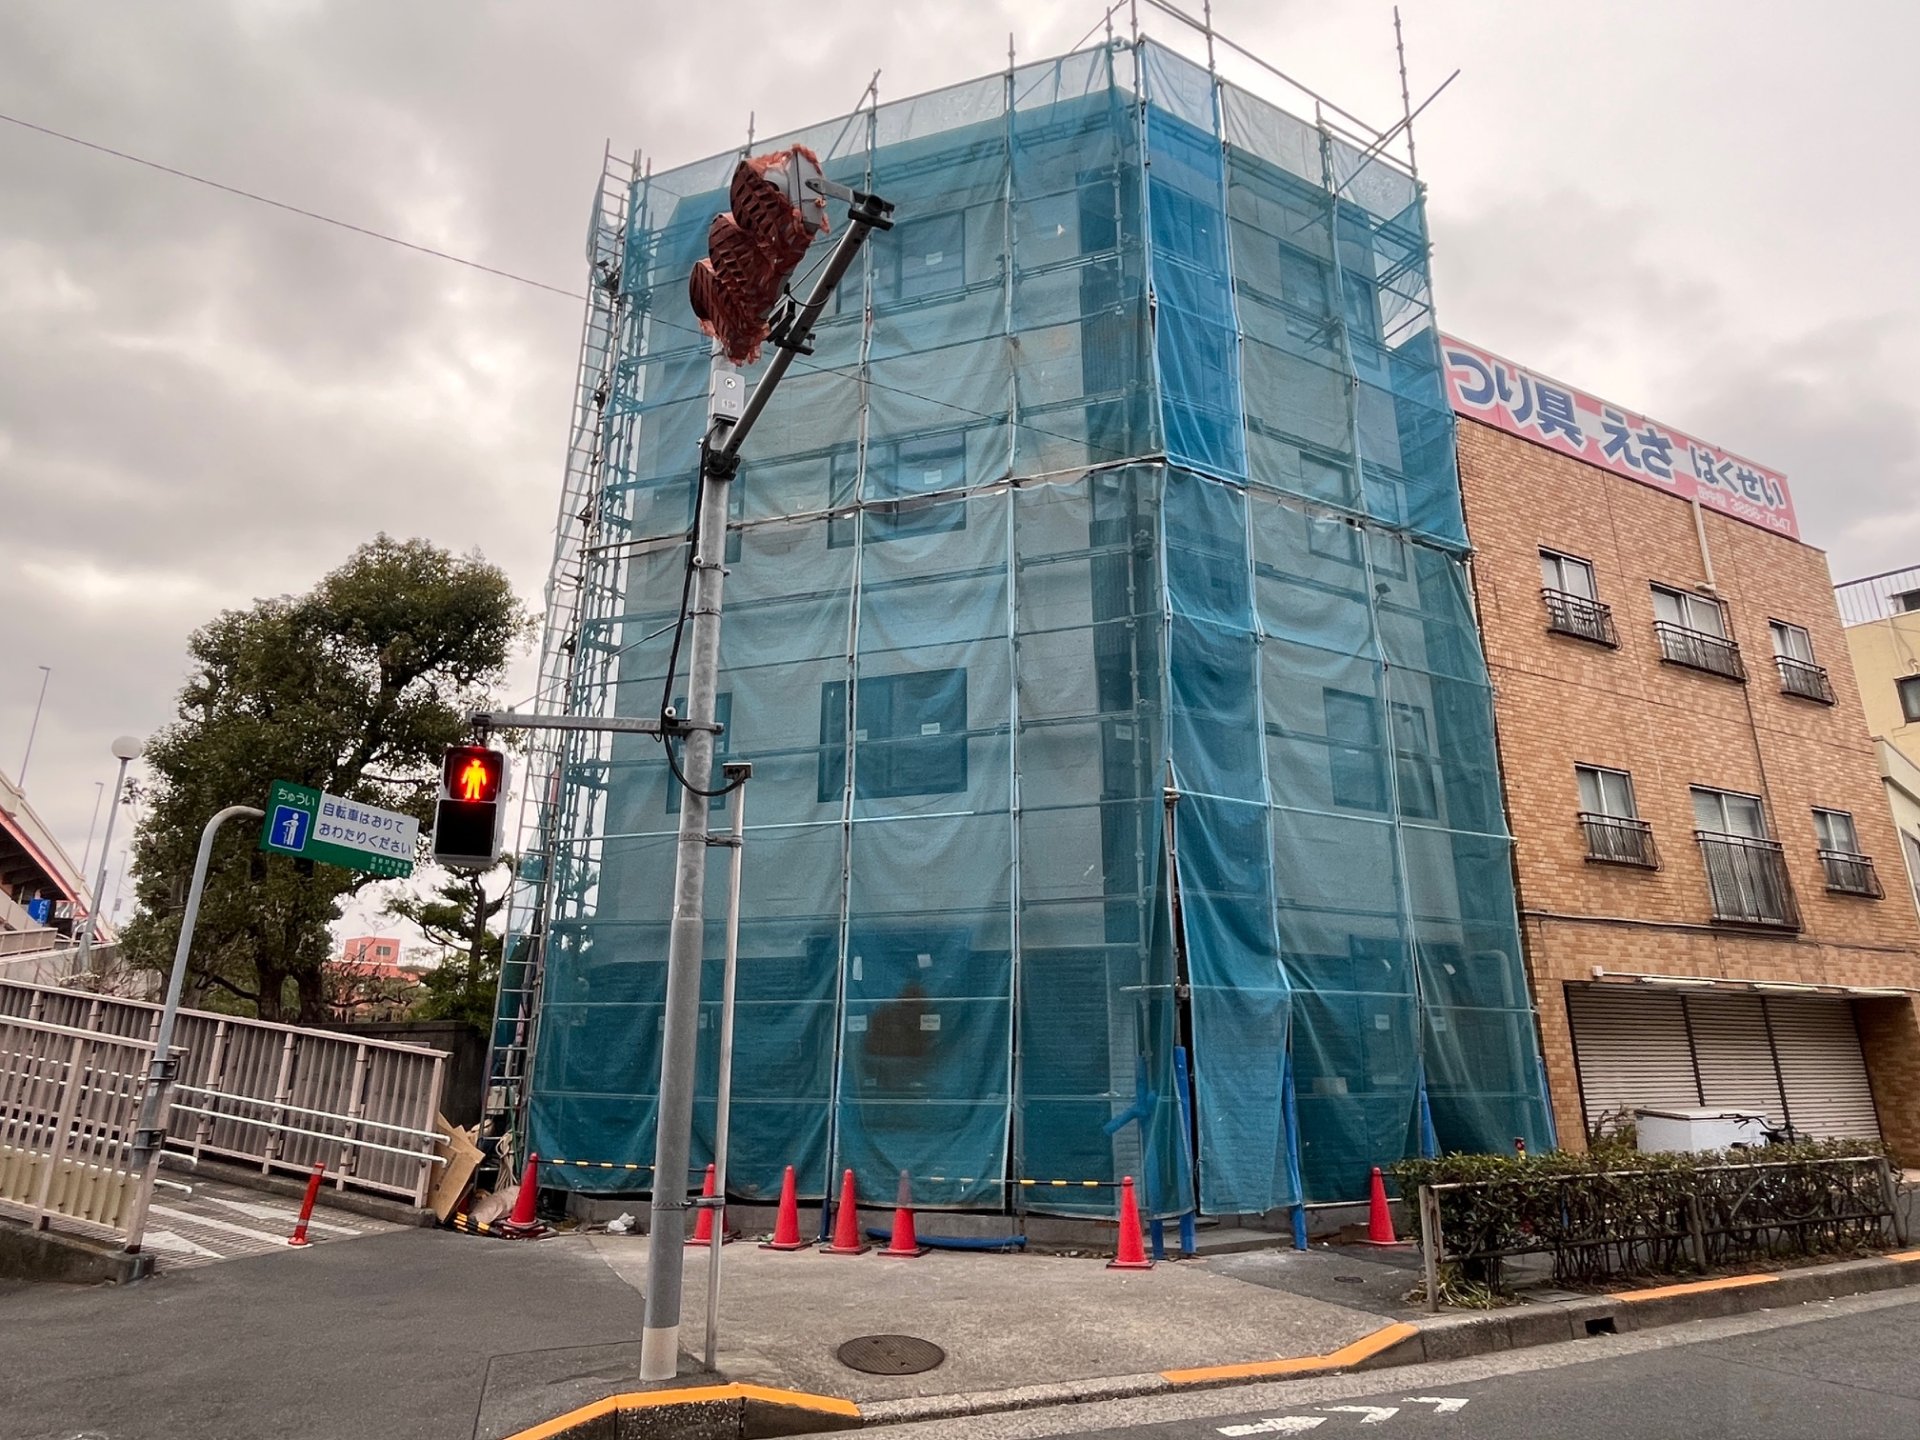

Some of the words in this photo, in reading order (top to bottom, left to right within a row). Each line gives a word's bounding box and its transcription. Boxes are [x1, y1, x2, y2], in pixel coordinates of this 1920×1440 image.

[1446, 351, 1585, 448] つり具
[1601, 409, 1674, 480] えさ
[1689, 445, 1784, 507] はくせい
[277, 787, 315, 806] ちゅうい
[322, 802, 404, 834] 自転車はおりて
[318, 823, 411, 854] おわたりください
